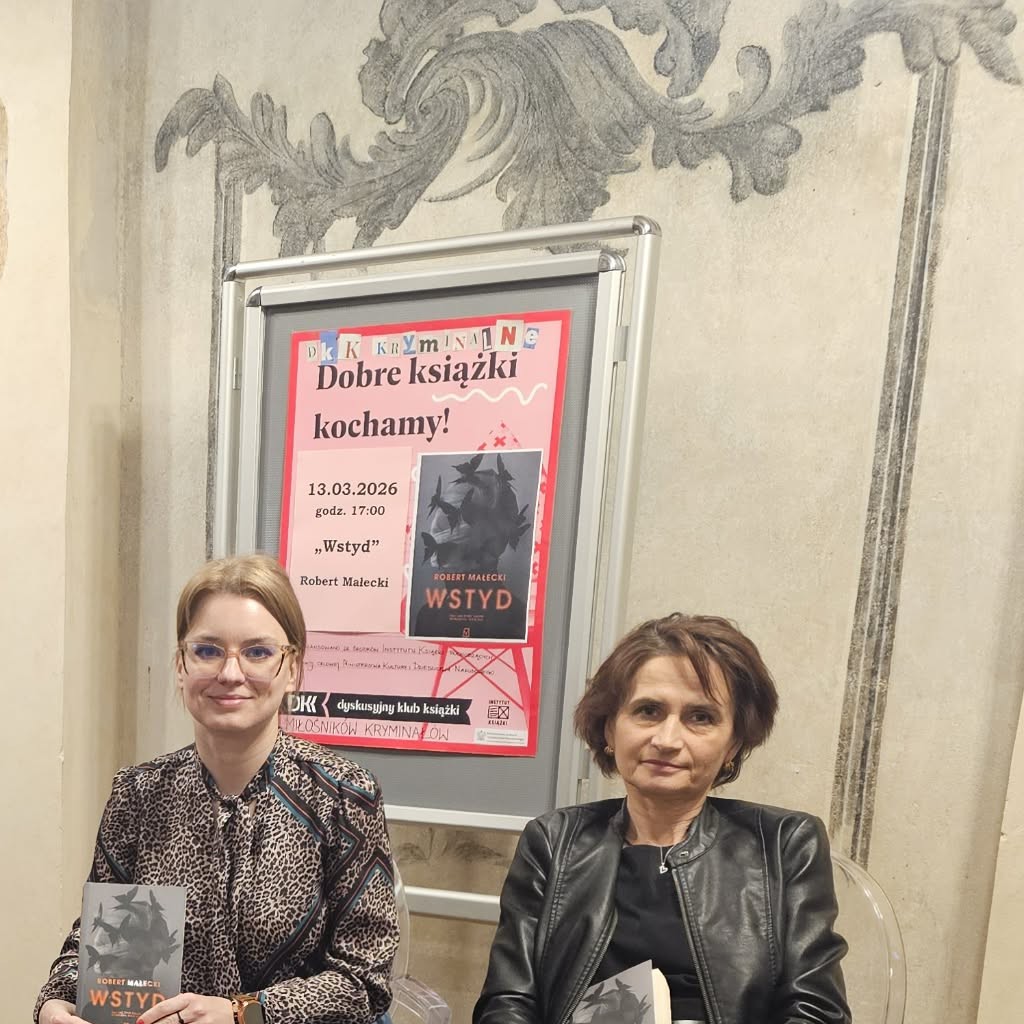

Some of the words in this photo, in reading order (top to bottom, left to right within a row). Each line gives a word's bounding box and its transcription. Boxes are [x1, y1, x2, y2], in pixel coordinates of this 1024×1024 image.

[316, 360, 402, 391] Dobre
[408, 352, 518, 389] książki
[313, 407, 450, 443] kochamy!
[308, 482, 398, 496] 13.03.2026
[315, 505, 347, 519] godz.
[351, 505, 386, 516] 17:00
[299, 575, 339, 587] Robert
[342, 576, 390, 588] Małecki
[433, 573, 466, 582] ROBERT
[467, 573, 507, 583] MAŁECKI
[425, 587, 513, 611] WSTYD
[337, 699, 395, 715] dyskusyjny
[397, 701, 421, 714] klub
[423, 702, 460, 718] książki
[97, 977, 126, 986] ROBERT
